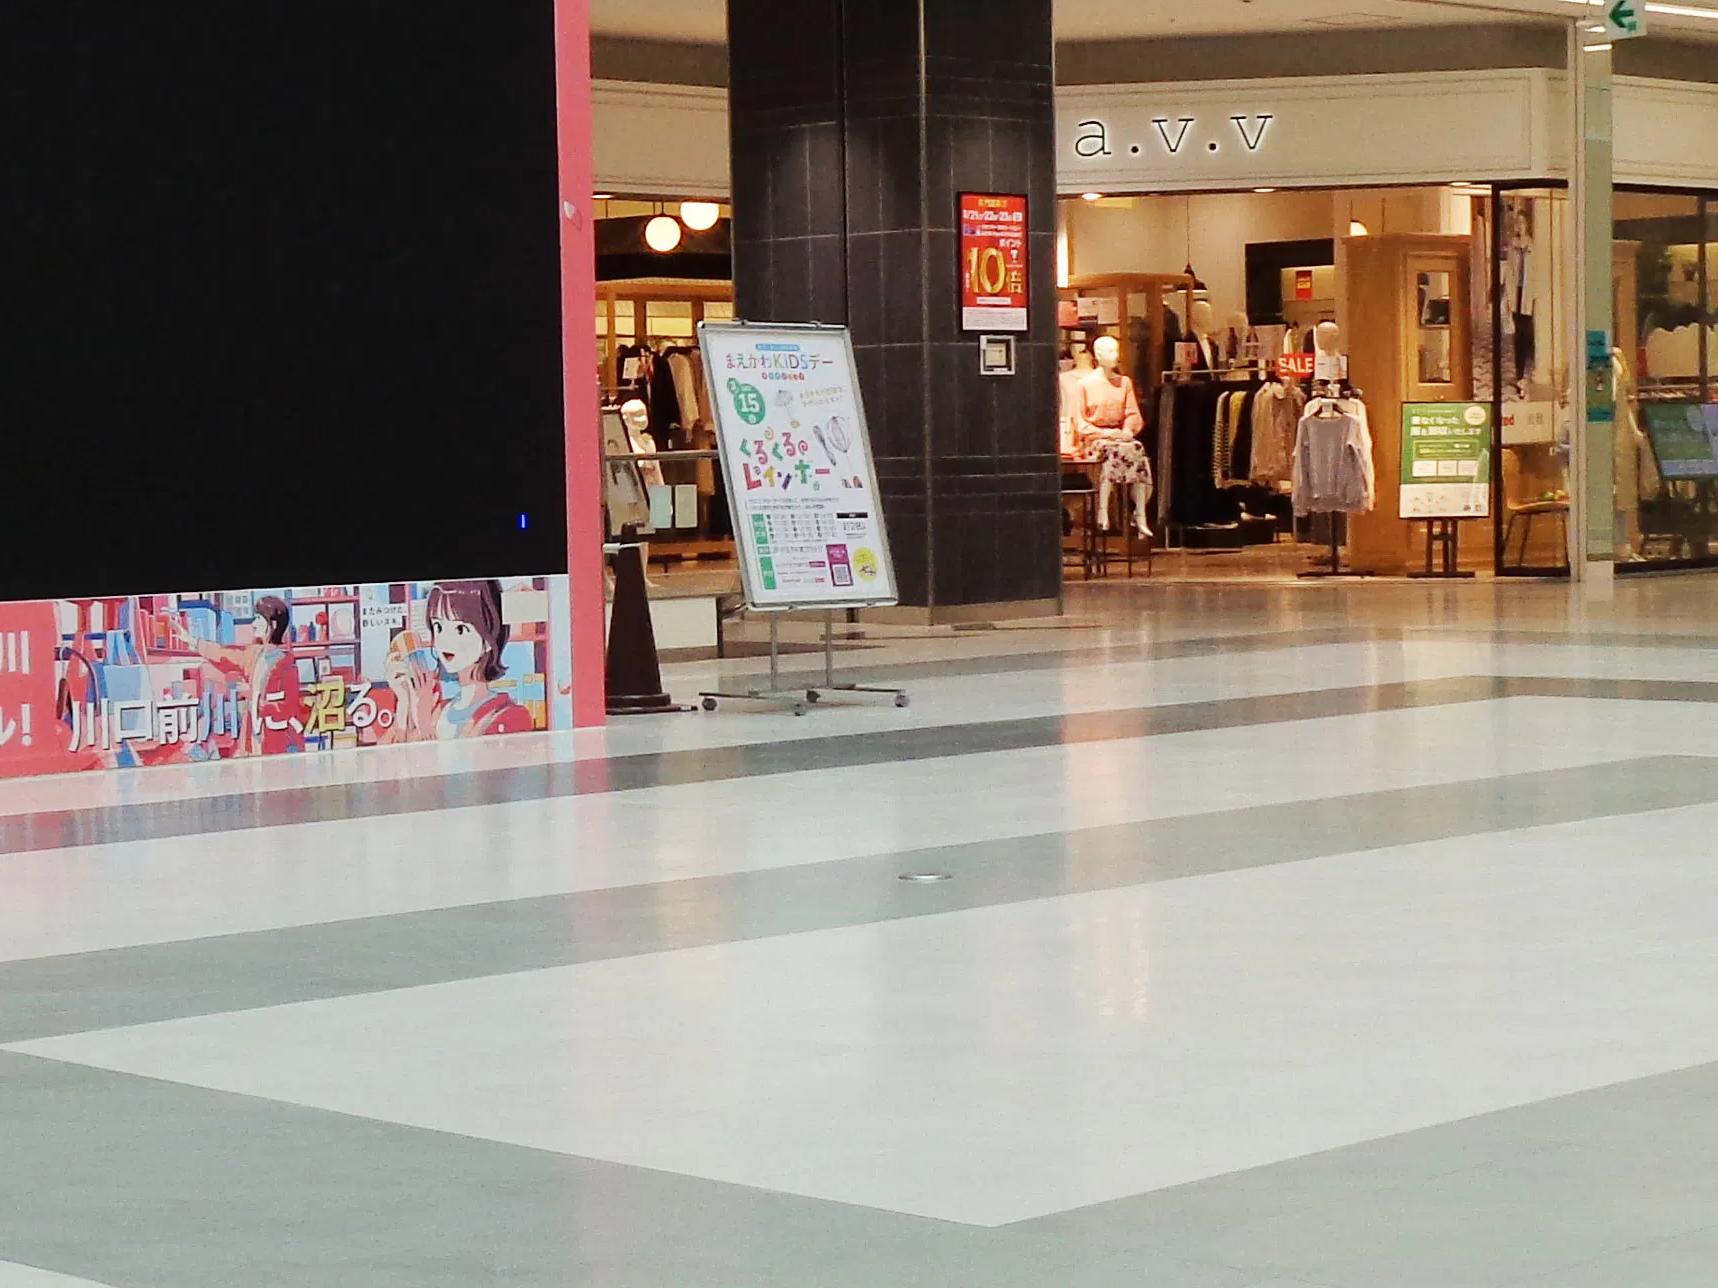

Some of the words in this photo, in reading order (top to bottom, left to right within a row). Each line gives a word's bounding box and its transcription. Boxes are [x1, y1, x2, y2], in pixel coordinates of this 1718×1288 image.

[1075, 115, 1273, 157] a.v.v
[1278, 357, 1314, 373] SALE
[738, 393, 760, 413] 15
[67, 676, 396, 754] 川口前川に、沼る。
